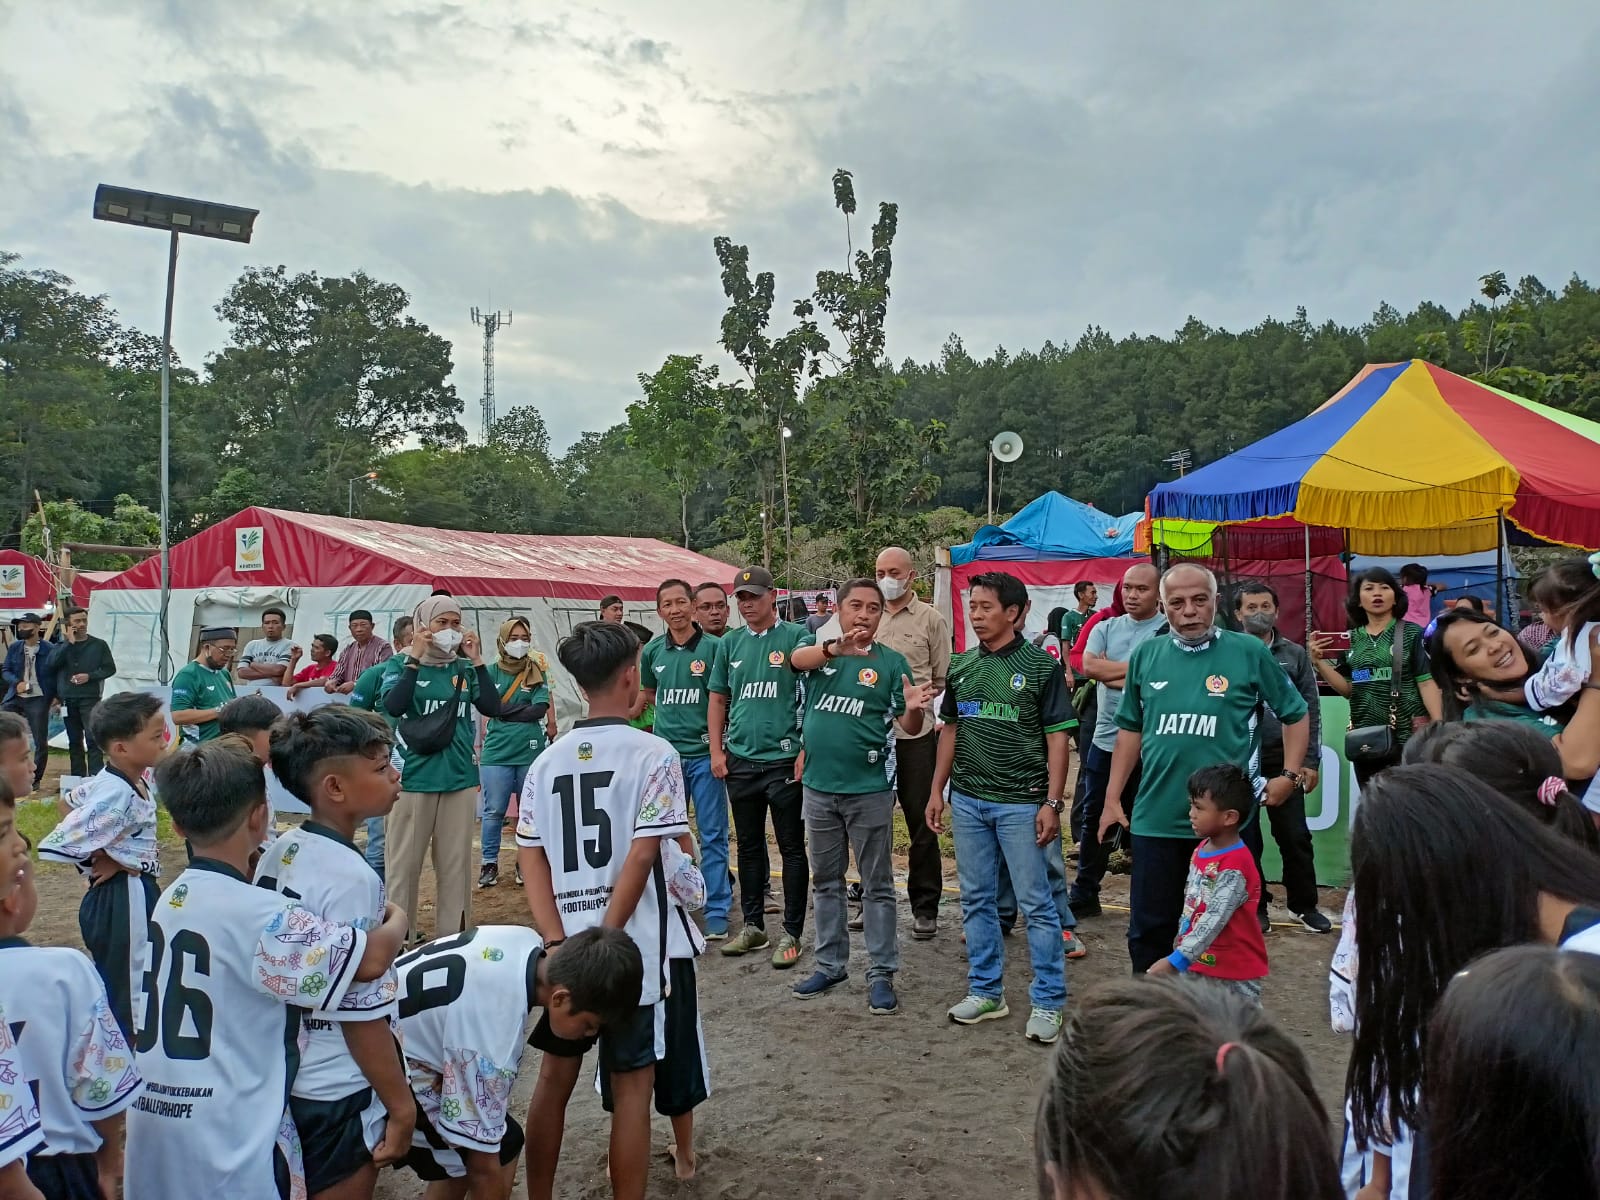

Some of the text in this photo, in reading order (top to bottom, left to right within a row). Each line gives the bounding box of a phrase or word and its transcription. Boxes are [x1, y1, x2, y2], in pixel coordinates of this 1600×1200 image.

[662, 688, 700, 704] JATIM
[739, 681, 777, 700] JATIM
[814, 693, 864, 717] JATIM
[1155, 713, 1217, 738] JATIM
[552, 770, 615, 873] 15
